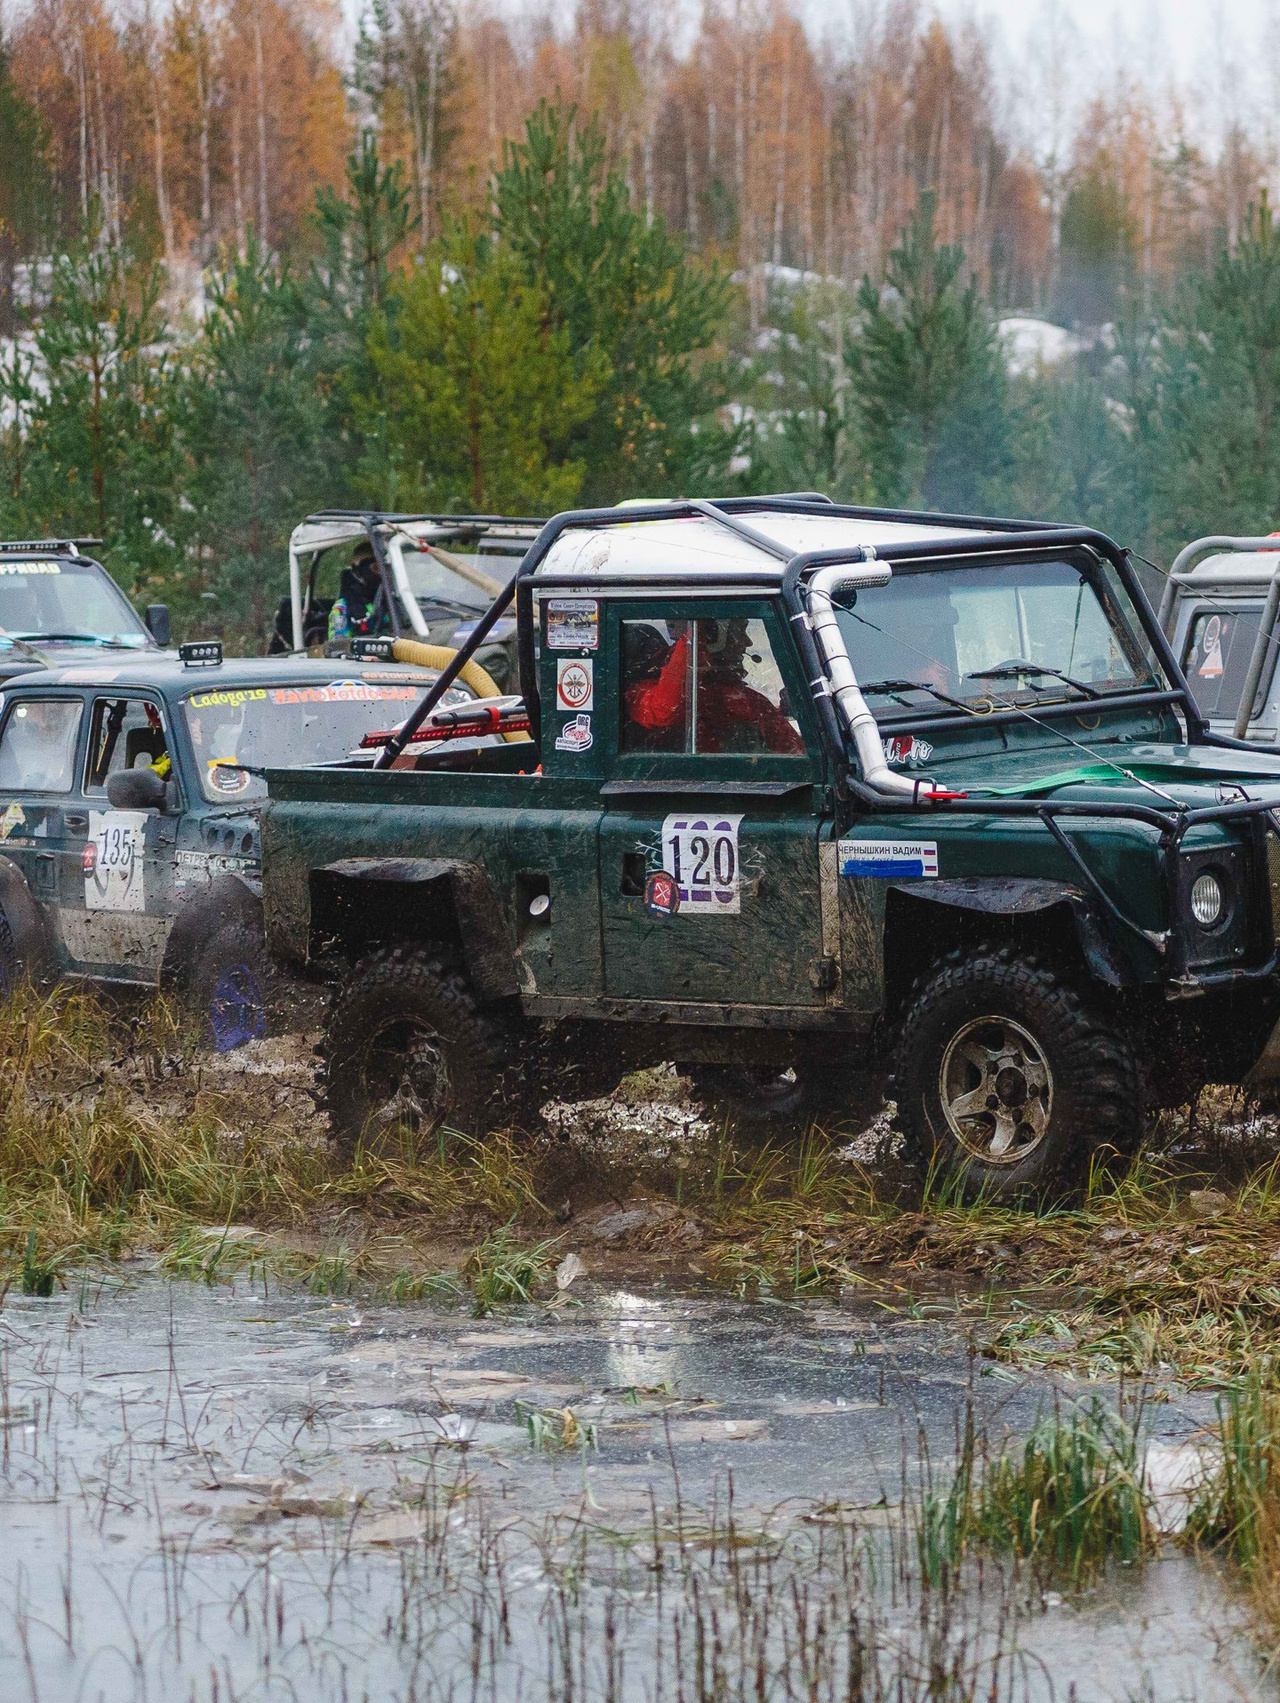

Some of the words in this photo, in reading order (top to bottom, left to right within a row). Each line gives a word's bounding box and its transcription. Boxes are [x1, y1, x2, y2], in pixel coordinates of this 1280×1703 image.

[100, 828, 132, 866] 135
[668, 835, 735, 886] 120
[839, 845, 890, 855] ЧЕРНЫШКИН
[892, 846, 922, 856] ВАДИМ
